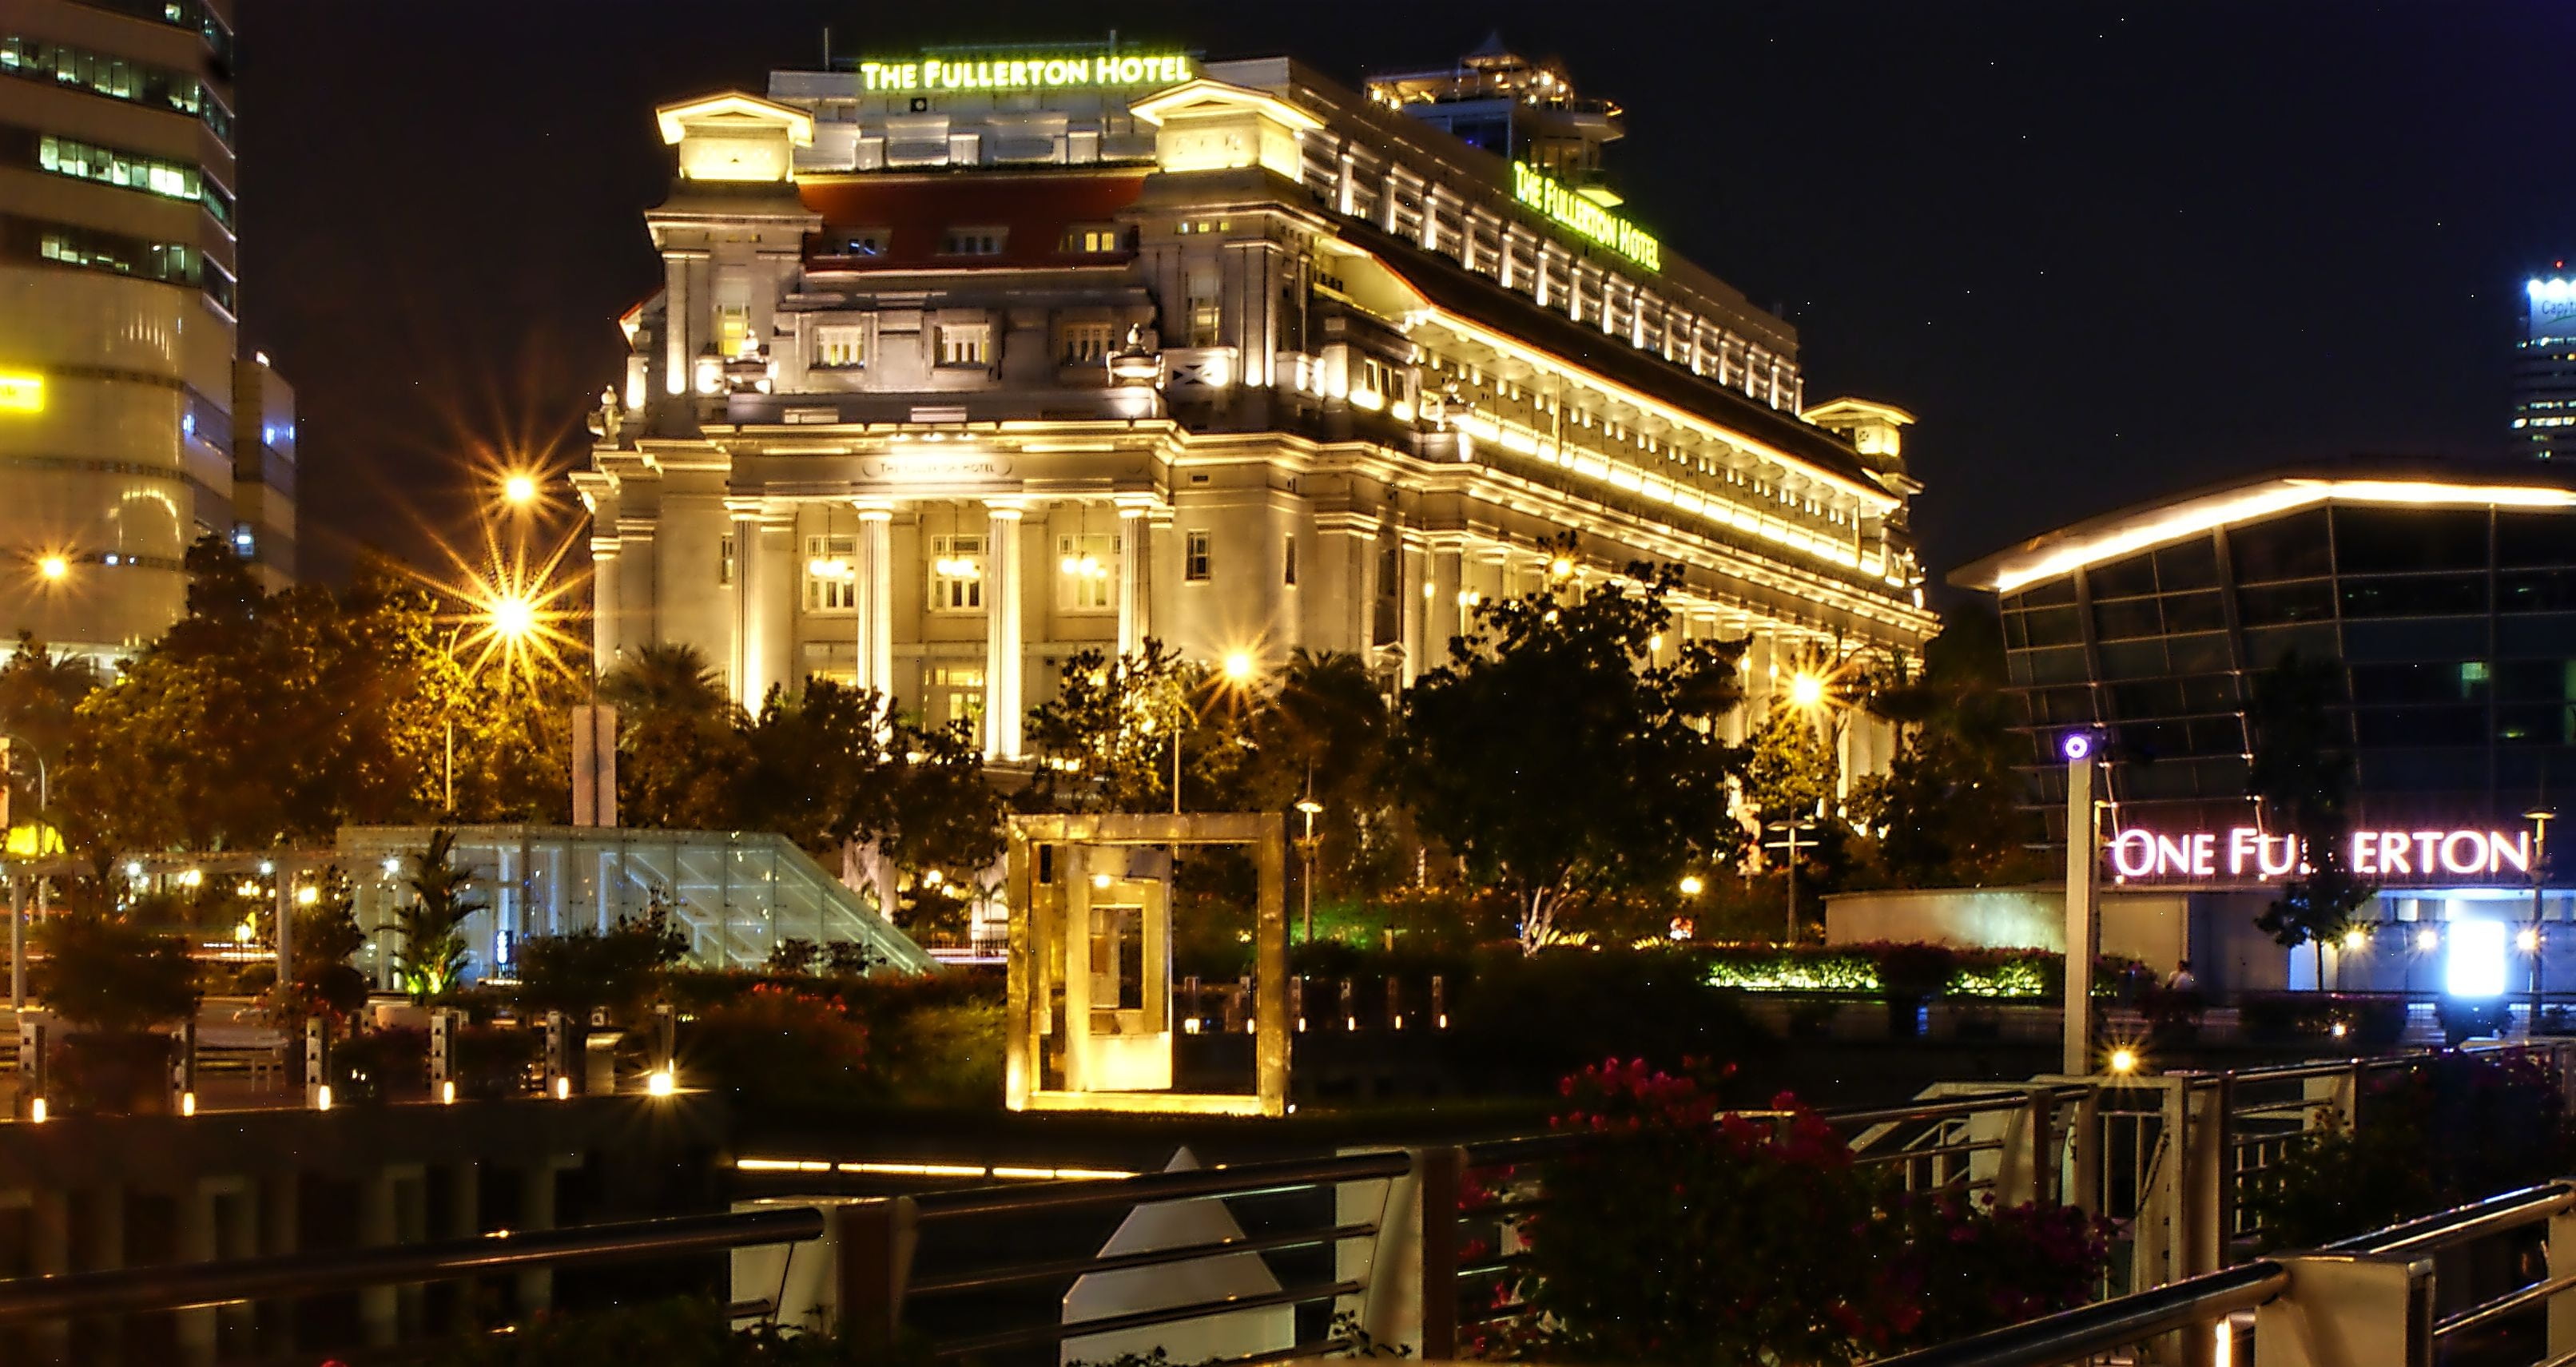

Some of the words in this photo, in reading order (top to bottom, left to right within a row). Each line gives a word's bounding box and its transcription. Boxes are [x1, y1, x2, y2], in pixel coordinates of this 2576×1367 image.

[861, 62, 916, 90] THE
[925, 58, 1089, 89] FULLERTON
[1096, 57, 1192, 85] HOTEL
[1514, 161, 1542, 209] THE
[1544, 177, 1617, 249] FULLERTON
[1620, 218, 1660, 272] HOTEL
[2113, 829, 2216, 876] ONE
[2230, 827, 2530, 876] FUERTON
